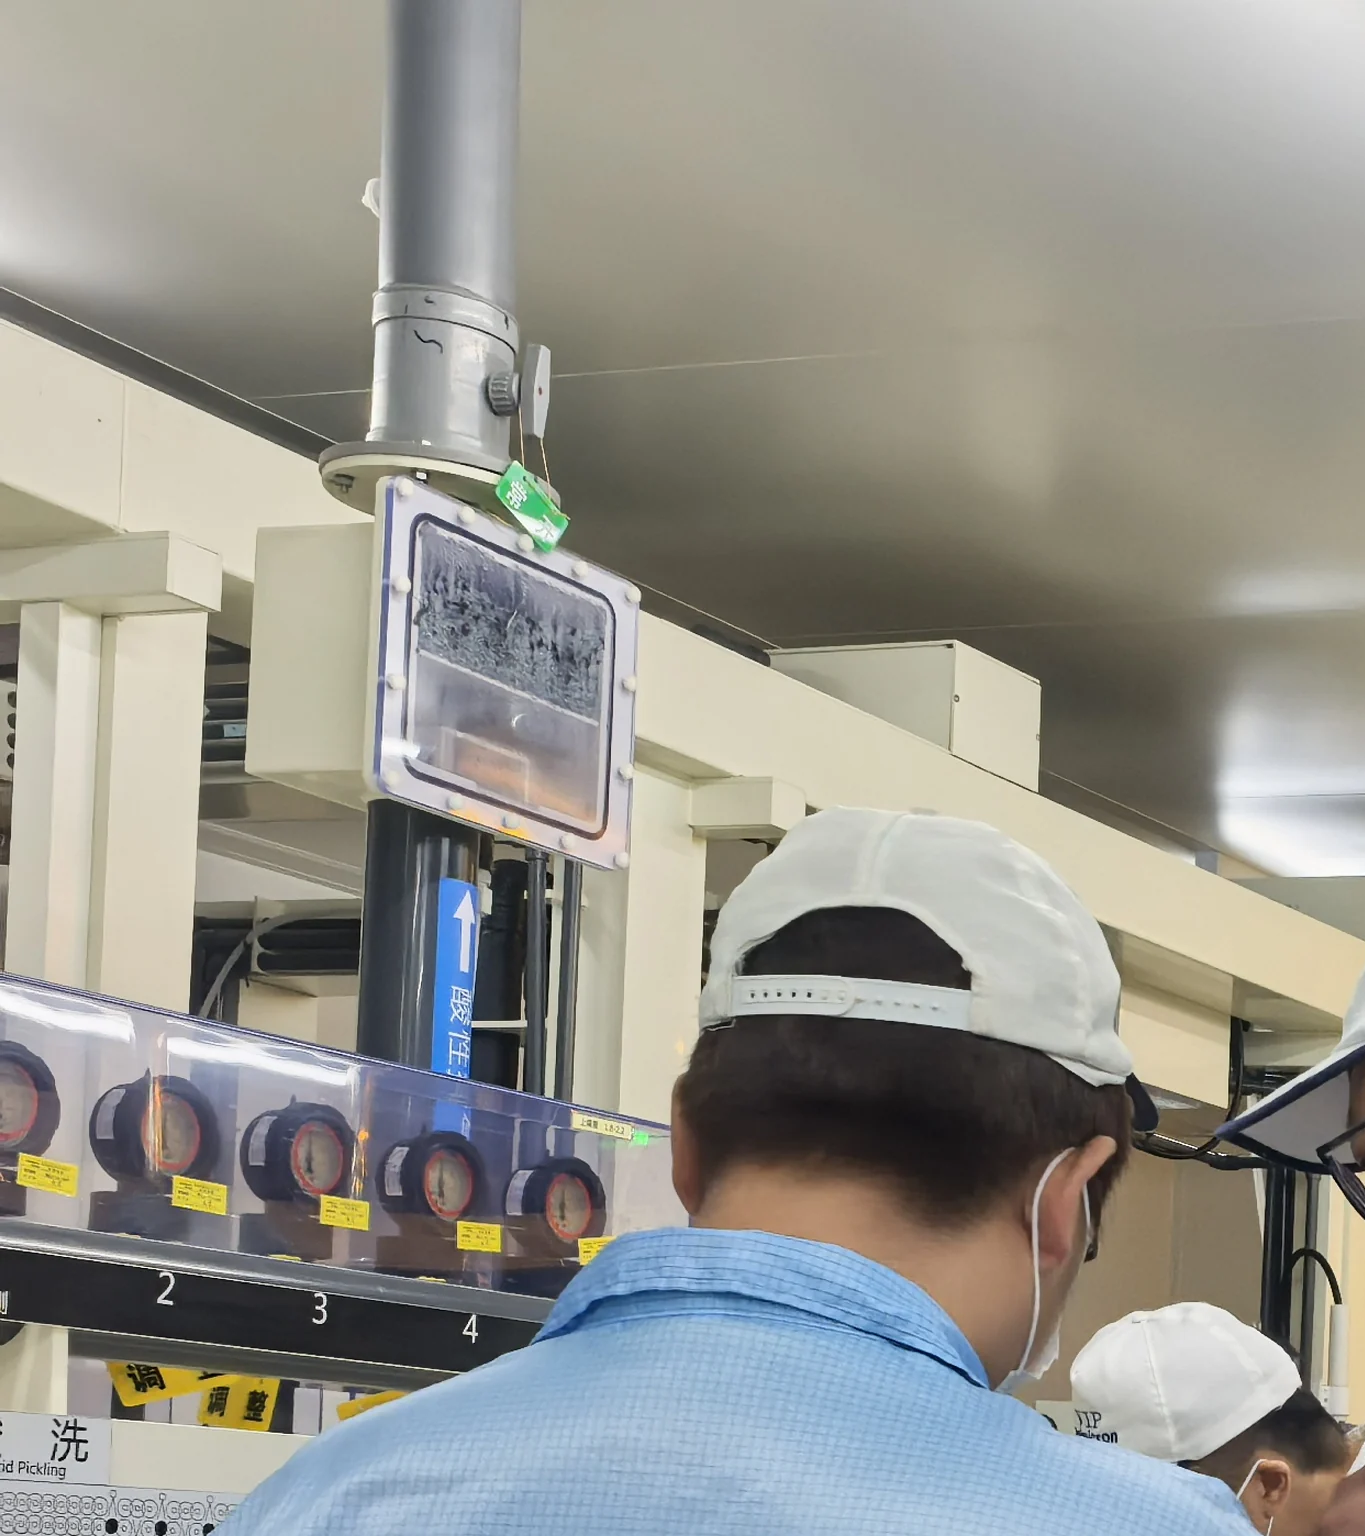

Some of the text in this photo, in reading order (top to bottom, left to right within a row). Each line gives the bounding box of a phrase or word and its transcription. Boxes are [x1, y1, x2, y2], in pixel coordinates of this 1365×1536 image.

[448, 985, 473, 1080] 酸性
[157, 1272, 479, 1344] 2 3 4
[50, 1418, 89, 1462] 洗
[18, 1460, 66, 1480] Pickling
